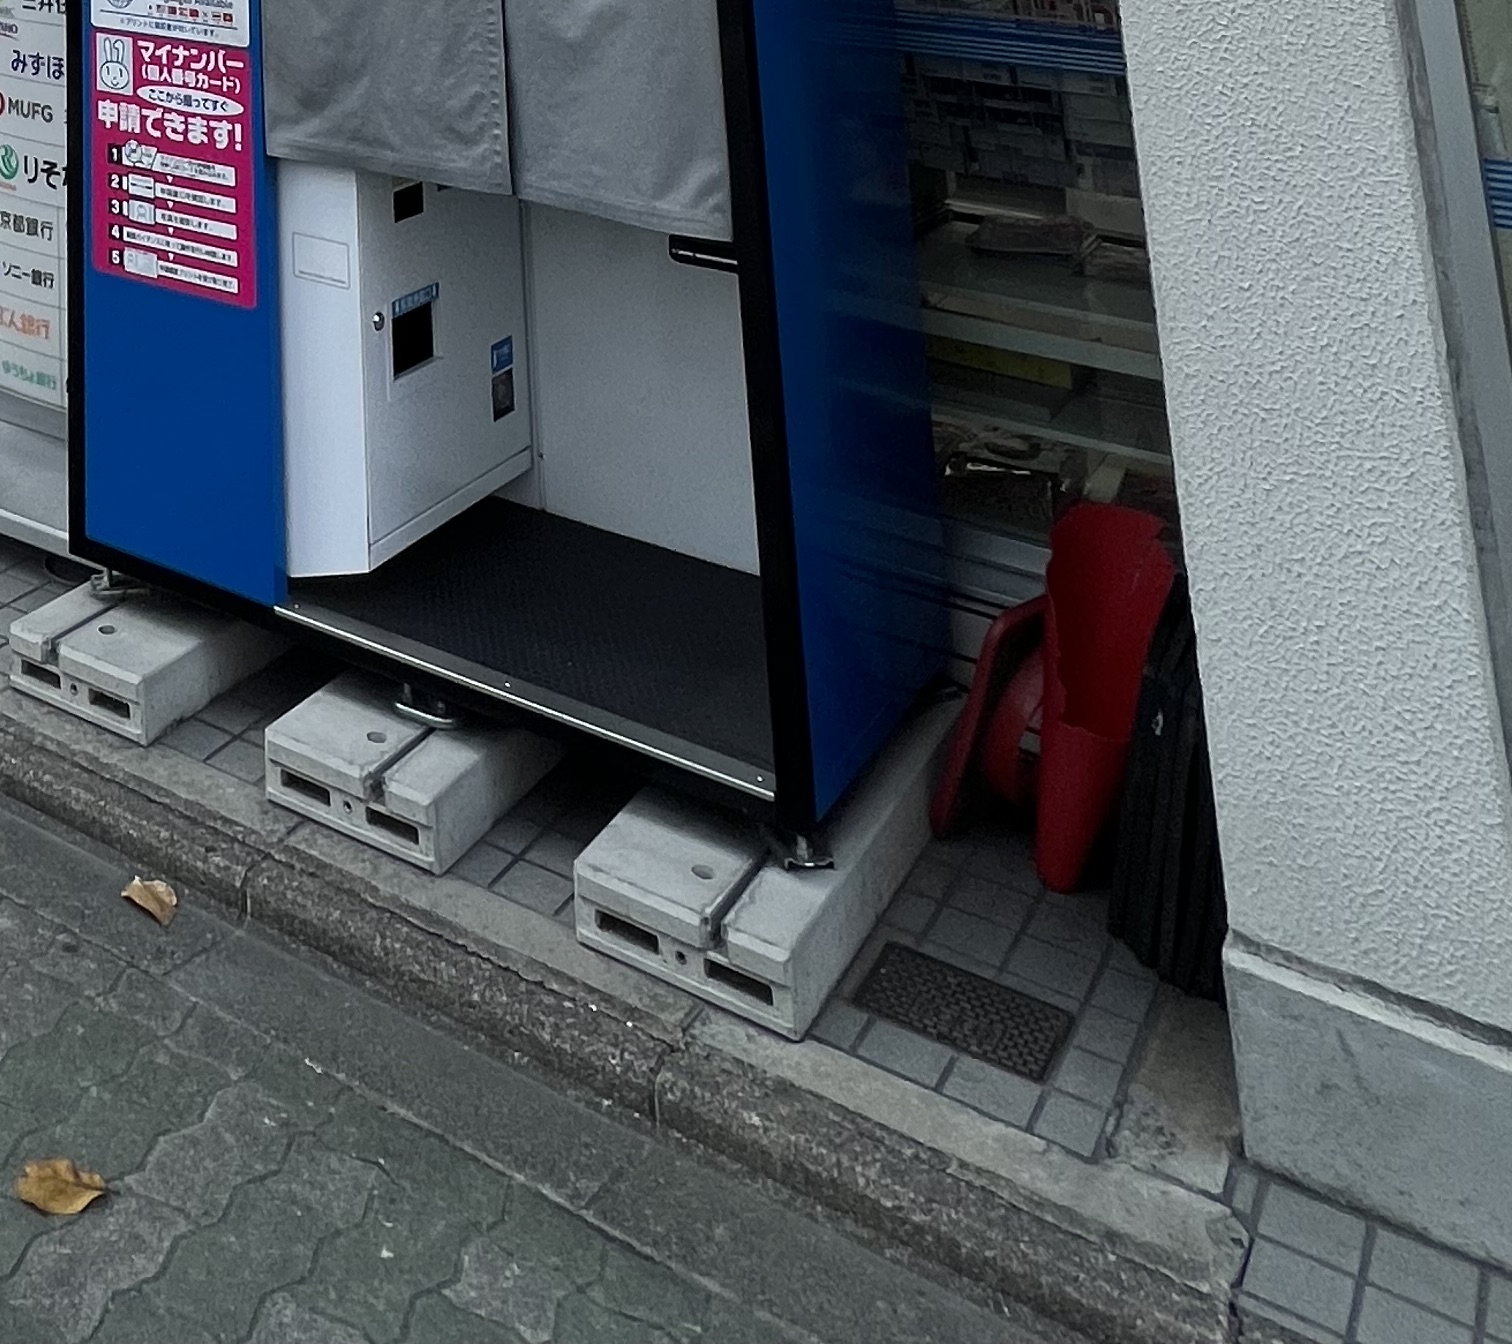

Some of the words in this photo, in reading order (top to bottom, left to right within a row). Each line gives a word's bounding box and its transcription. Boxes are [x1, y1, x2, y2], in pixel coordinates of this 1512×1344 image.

[10, 49, 66, 81] みずほ
[136, 39, 245, 74] マイナンバー
[7, 95, 54, 124] MUFG
[96, 98, 243, 152] 申請できます!
[23, 154, 68, 190] りそ
[110, 175, 120, 189] 2
[110, 199, 120, 214] 3
[0, 210, 54, 242] 京都銀行
[110, 224, 120, 239] 4
[110, 249, 120, 264] 5
[2, 261, 55, 290] ソニー銀行
